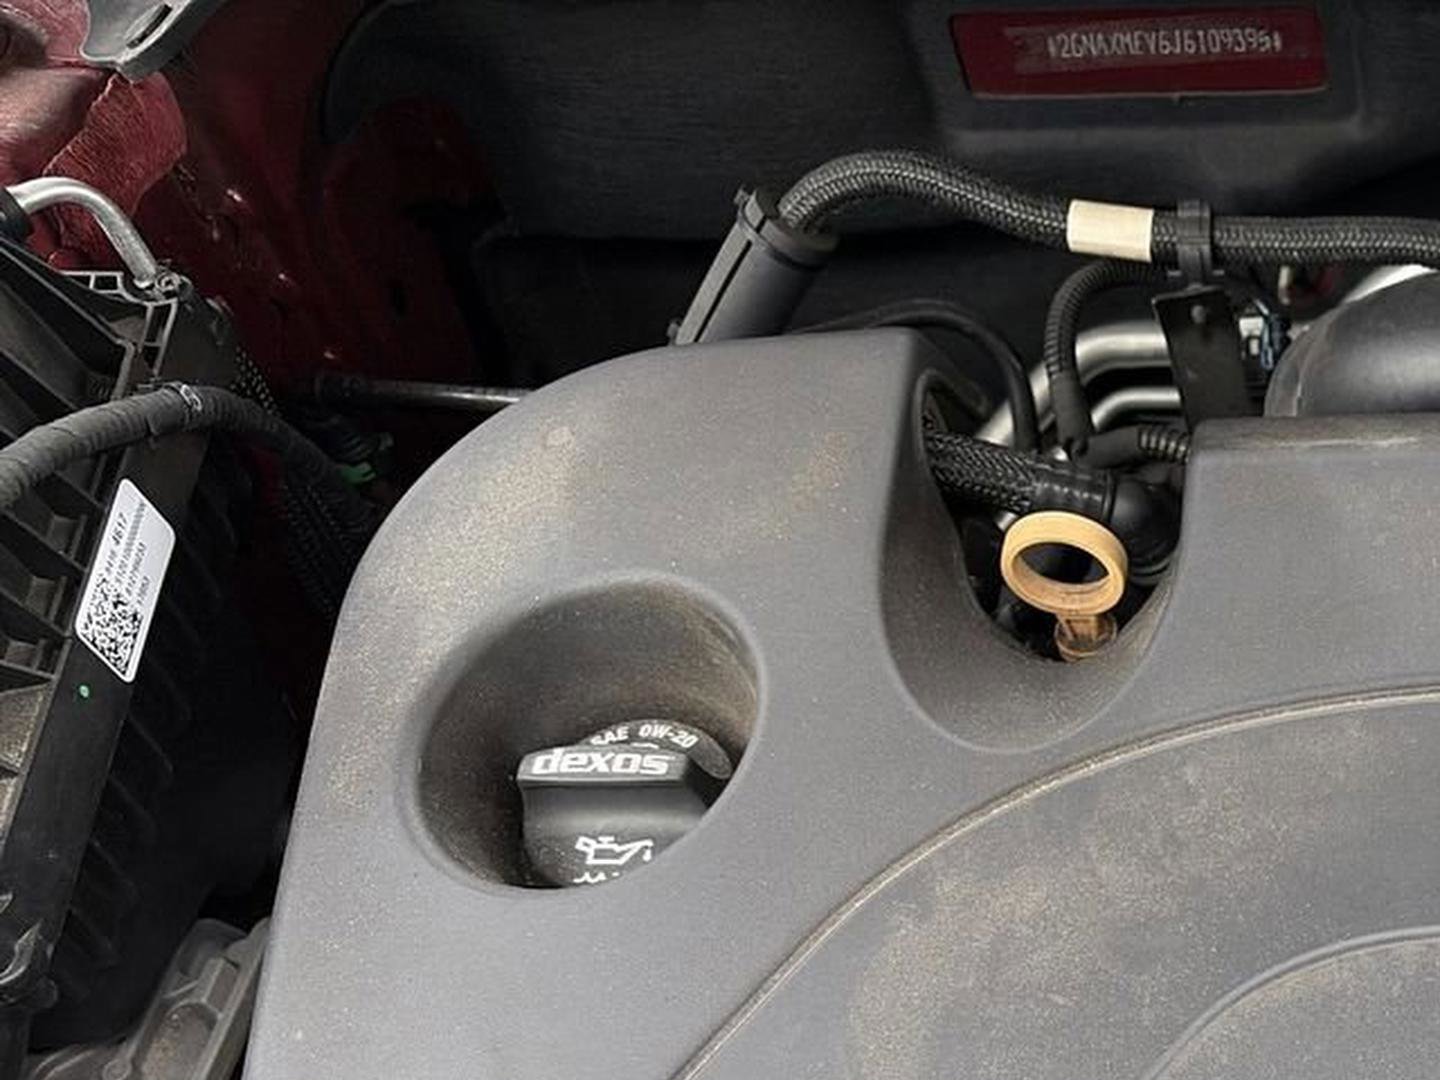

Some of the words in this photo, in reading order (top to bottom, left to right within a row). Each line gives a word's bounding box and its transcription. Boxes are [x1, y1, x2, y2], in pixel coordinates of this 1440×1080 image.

[590, 726, 630, 746] SAE
[638, 724, 699, 749] 0W-20
[531, 747, 672, 776] dexos
